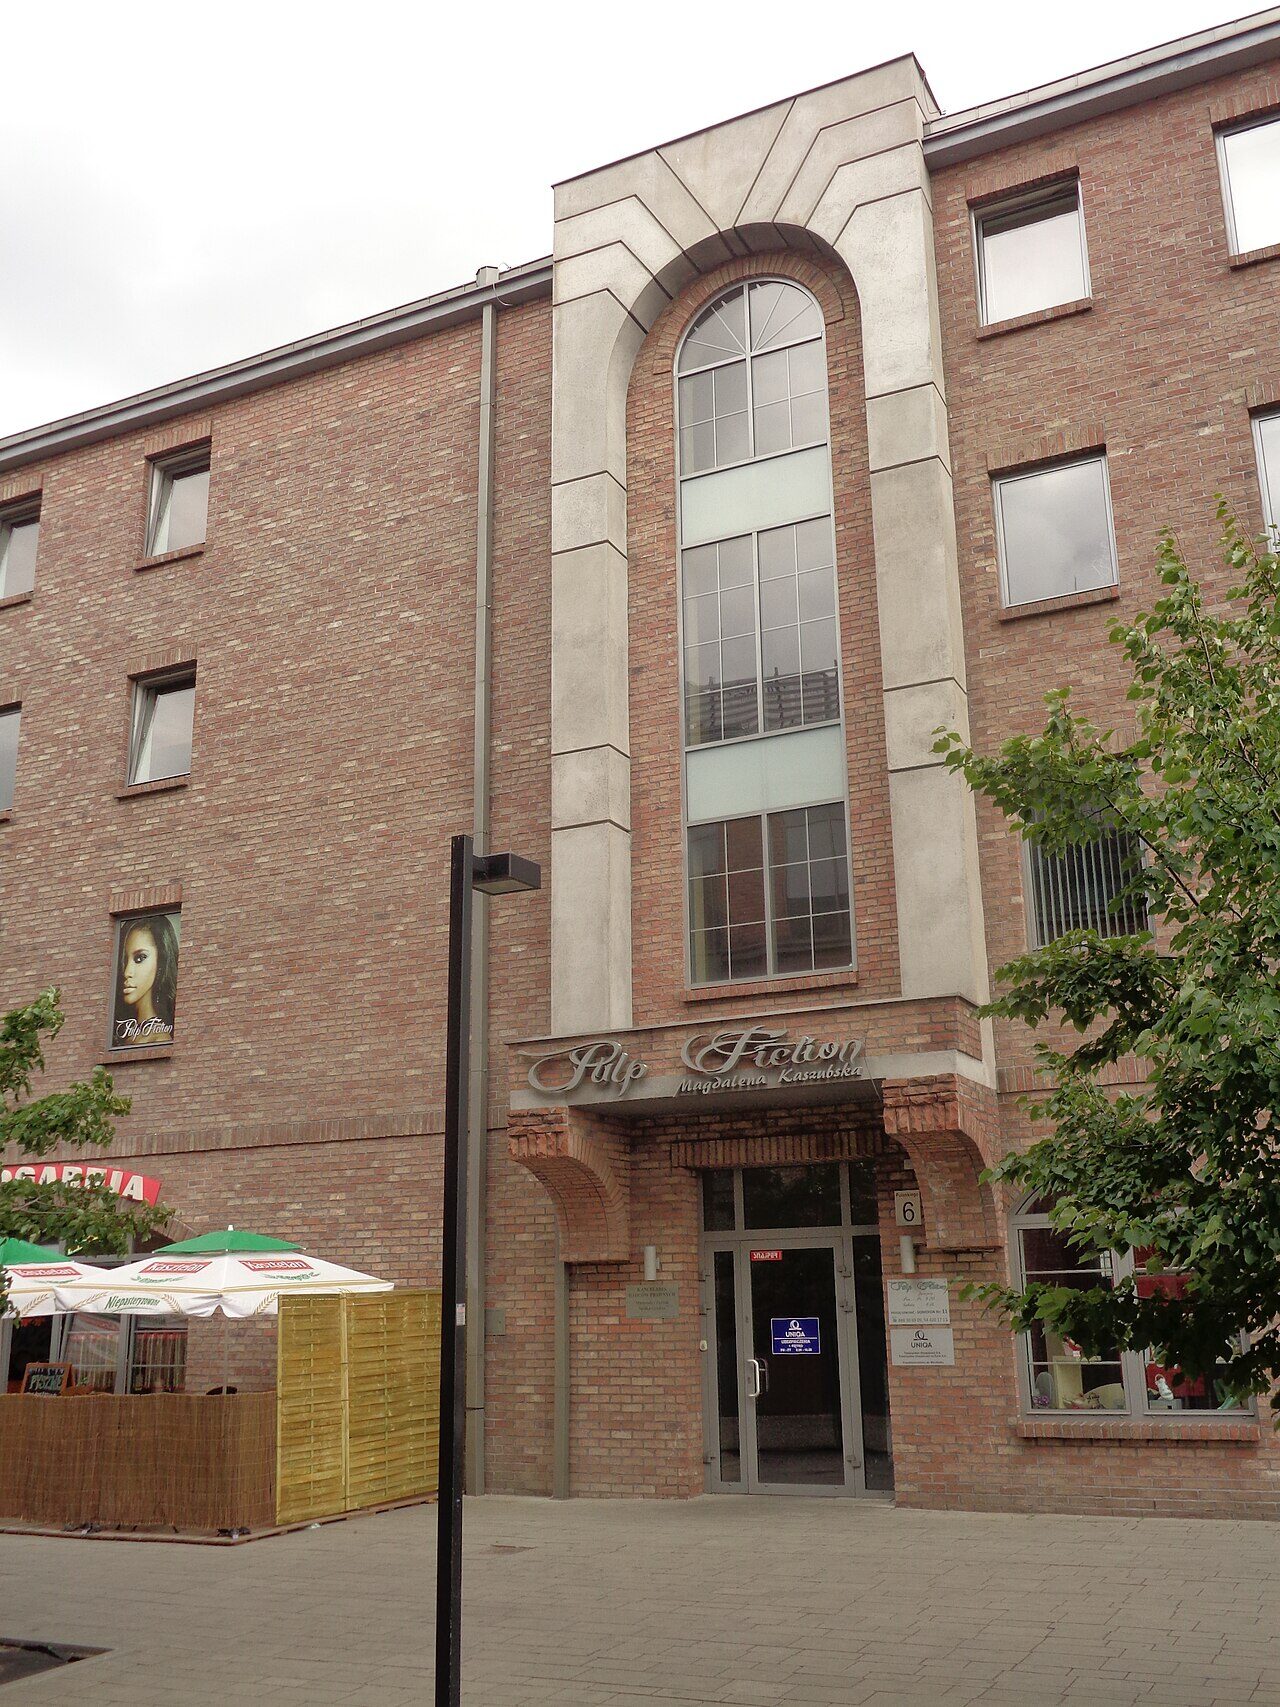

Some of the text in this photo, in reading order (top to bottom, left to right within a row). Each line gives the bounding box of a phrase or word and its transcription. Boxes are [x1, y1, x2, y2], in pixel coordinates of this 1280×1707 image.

[517, 1025, 862, 1097] Pulp Fiction
[673, 1062, 863, 1097] Magdalena Kaszubska
[903, 1201, 915, 1222] 6
[146, 1262, 206, 1272] Kasztelan
[241, 1260, 306, 1270] Kasztelan
[910, 1341, 932, 1349] UNIQA
